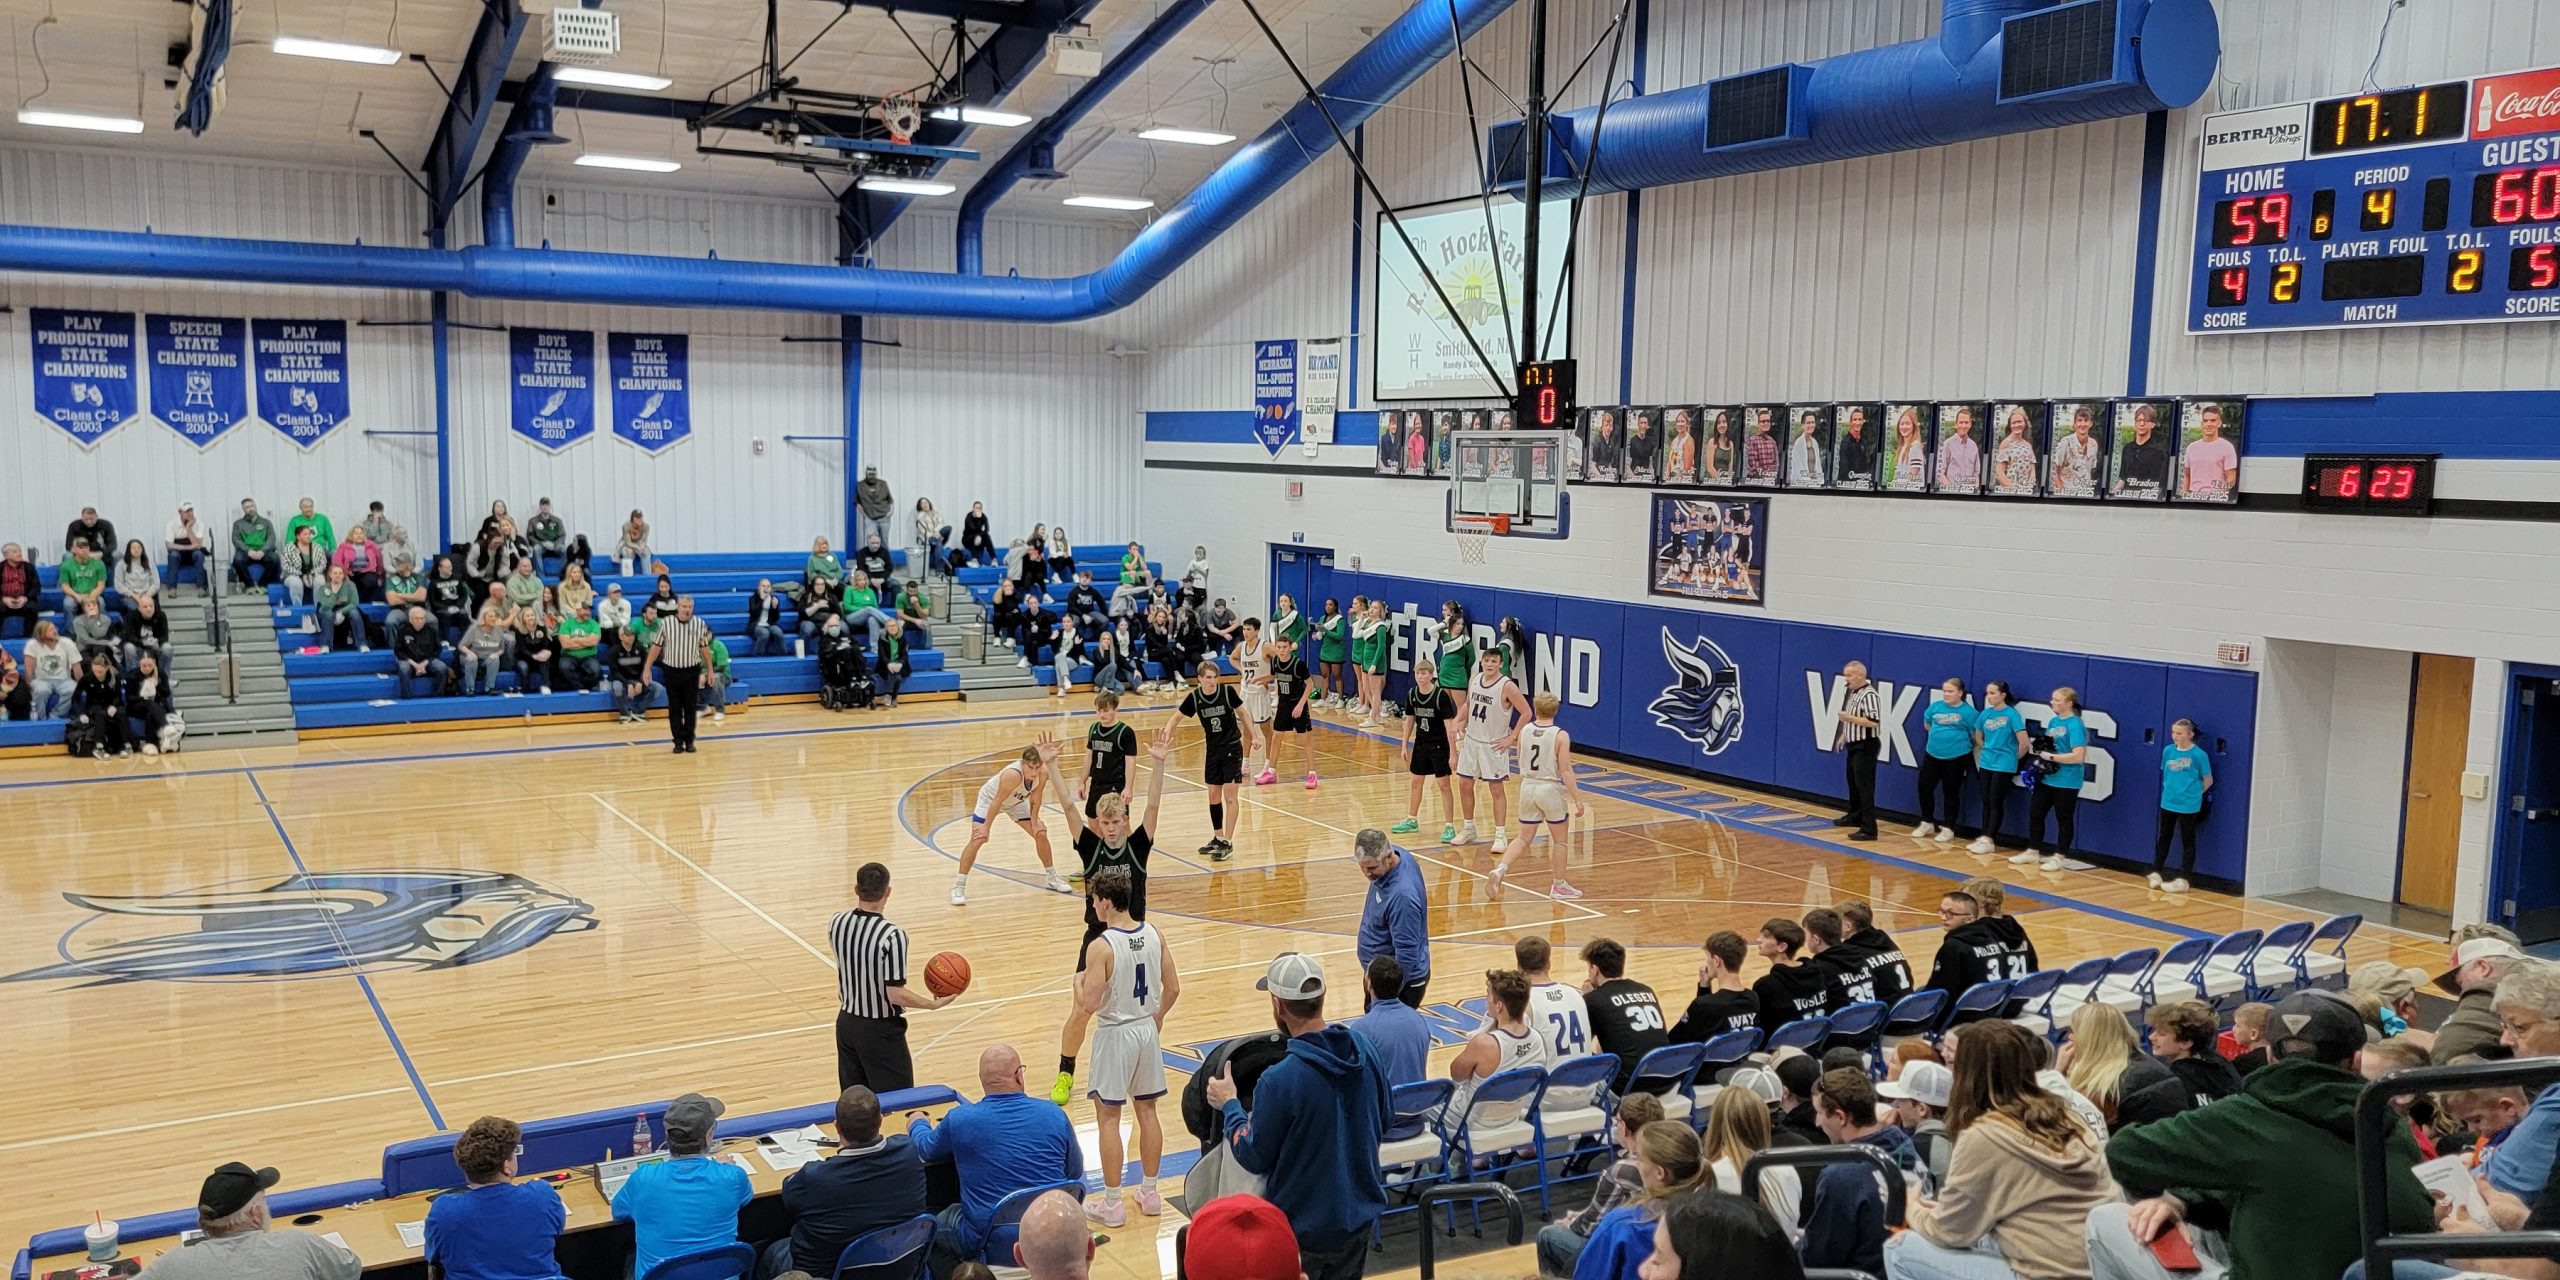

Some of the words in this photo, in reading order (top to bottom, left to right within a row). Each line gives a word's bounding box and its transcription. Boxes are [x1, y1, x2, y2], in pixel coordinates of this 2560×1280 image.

[2336, 90, 2427, 145] 17.1
[2207, 123, 2300, 146] BERTRAND
[2268, 135, 2302, 145] Vikings
[2225, 168, 2285, 194] HOME
[2354, 166, 2409, 186] PERIOD
[2493, 168, 2560, 223] 60
[2368, 191, 2391, 224] 4
[2231, 194, 2289, 245] 59
[2446, 233, 2490, 250] T.O.L.
[2509, 227, 2560, 246] FOULS
[1440, 225, 1488, 266] Hock
[2321, 241, 2378, 259] PLAYER
[2389, 237, 2428, 254] FOUL
[2208, 251, 2251, 267] FOULS
[2268, 247, 2306, 263] T.O.L.
[2452, 252, 2478, 291] 2
[2530, 247, 2554, 287] 5
[2223, 270, 2244, 301] 4
[2274, 266, 2297, 301] 2
[2344, 305, 2397, 321] MATCH
[2505, 297, 2560, 314] SCORE
[64, 316, 102, 331] PLAY
[2203, 312, 2247, 328] SCORE
[170, 322, 222, 336] SPEECH
[283, 326, 317, 339] PLAY
[38, 331, 129, 348] PRODUCTION
[175, 337, 219, 351] STATE
[259, 339, 341, 354] PRODUCTION
[538, 334, 567, 348] BOYS
[635, 339, 663, 351] BOYS
[1435, 338, 1494, 357] Smithld,
[61, 347, 108, 363] STATE
[158, 351, 237, 367] CHAMPIONS
[281, 355, 323, 369] STATE
[534, 348, 572, 361] TRACK
[632, 352, 668, 364] TRACK
[44, 362, 127, 379] CHAMPIONS
[265, 369, 340, 383] CHAMPIONS
[534, 361, 571, 375] STATE
[633, 365, 668, 378] STATE
[520, 374, 587, 389] CHAMPIONS
[619, 378, 682, 391] CHAMPIONS
[1540, 388, 1555, 423] 0
[54, 408, 92, 421] Class
[95, 409, 119, 422] C-2
[169, 410, 204, 423] Class
[208, 413, 229, 424] D-1
[277, 413, 310, 425] Class
[314, 414, 334, 425] D-1
[533, 416, 563, 429] Class
[565, 418, 575, 429] D
[73, 421, 102, 433] 2003
[186, 423, 214, 434] 2004
[293, 425, 320, 436] 2004
[632, 418, 661, 430] Class
[663, 419, 673, 429] D
[542, 429, 566, 439] 2010
[641, 430, 663, 440] 2011
[1472, 704, 1487, 723] 44
[1211, 717, 1222, 732] 2
[1530, 744, 1540, 771] 2
[1987, 958, 2001, 982] 3
[2007, 955, 2027, 980] 21
[1133, 963, 1148, 1006] 4
[1895, 964, 1910, 989] 1
[1611, 993, 1656, 1006] OLESEN
[1794, 990, 1827, 1010] VOSLE
[1625, 1006, 1663, 1031] 30
[1728, 1013, 1757, 1028] WAY
[1549, 1010, 1585, 1056] 24
